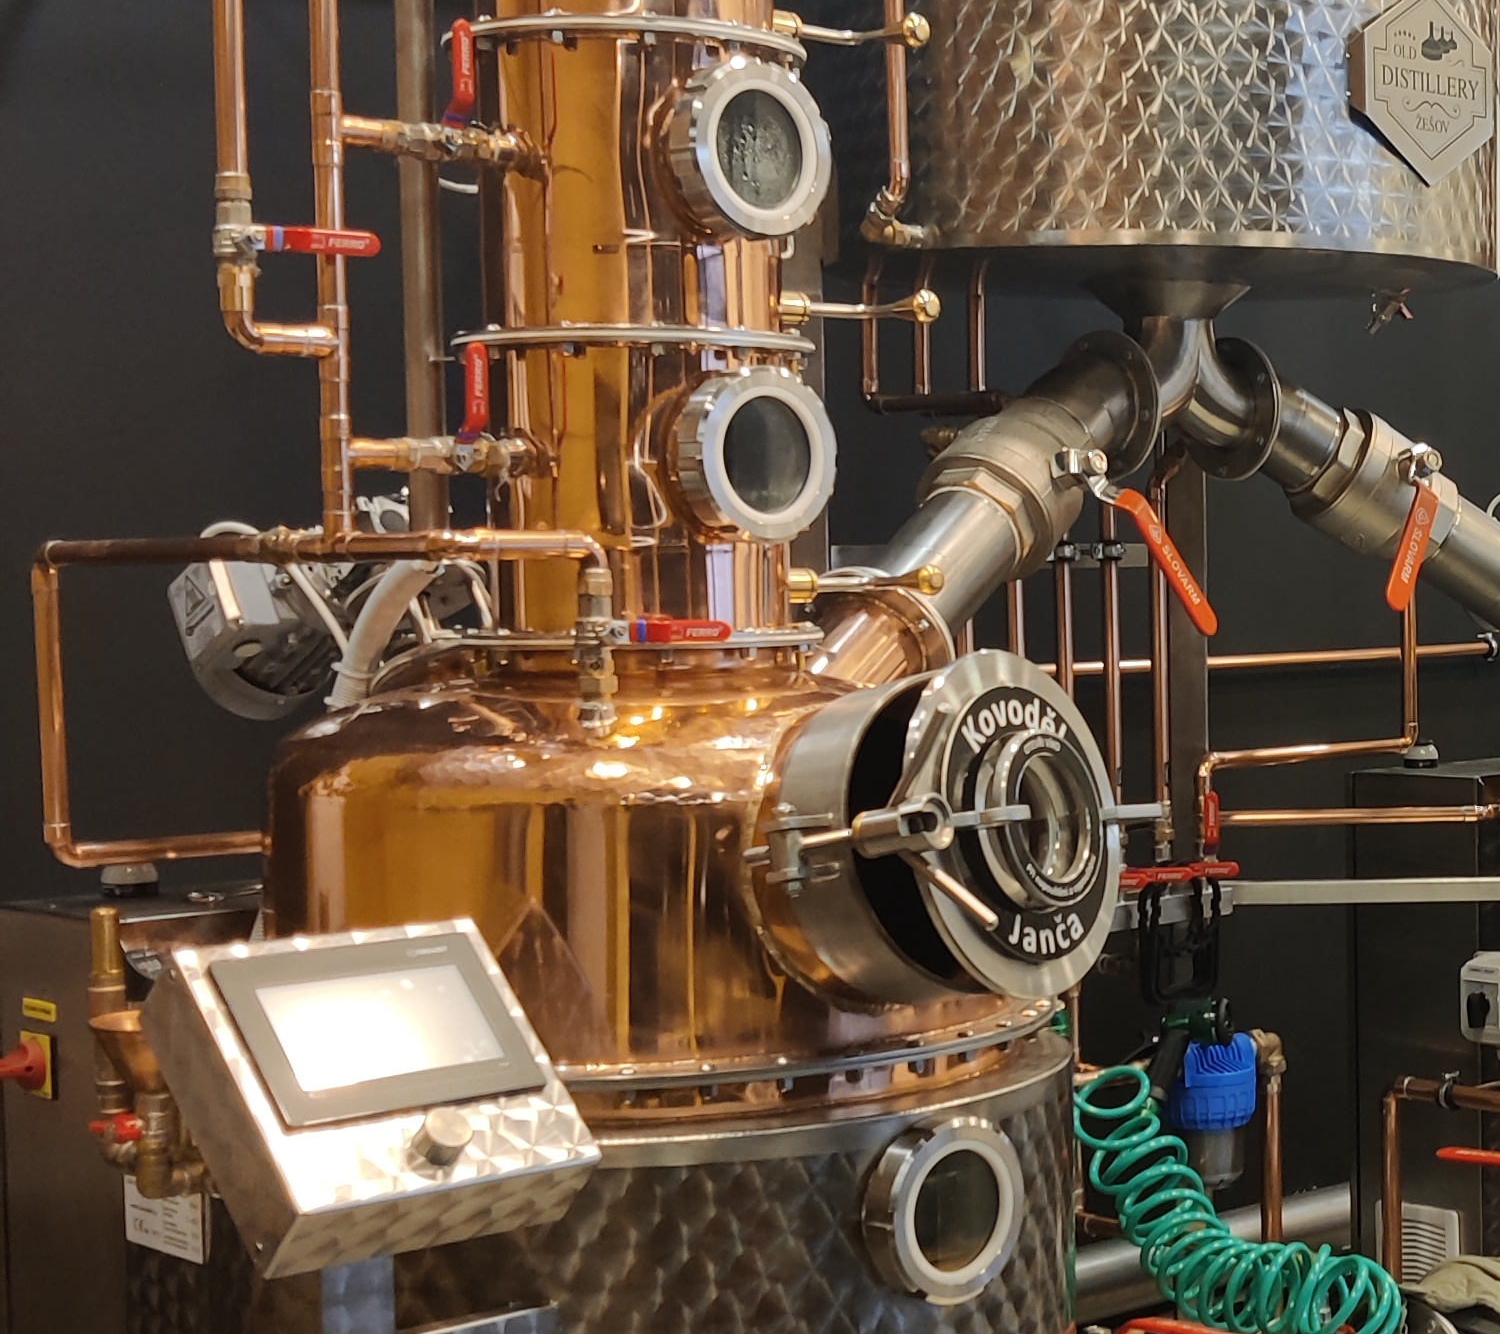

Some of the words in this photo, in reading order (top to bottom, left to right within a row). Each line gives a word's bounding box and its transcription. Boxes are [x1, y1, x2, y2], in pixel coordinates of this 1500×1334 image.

[1393, 43, 1417, 61] OLD
[1381, 64, 1479, 101] DISTILLERY
[1415, 113, 1450, 134] ŽEŠOV
[1162, 544, 1201, 605] SLOVARM
[1401, 528, 1423, 585] SLOVARM
[961, 697, 1068, 754] Kovoděl
[1008, 912, 1085, 956] Janča
